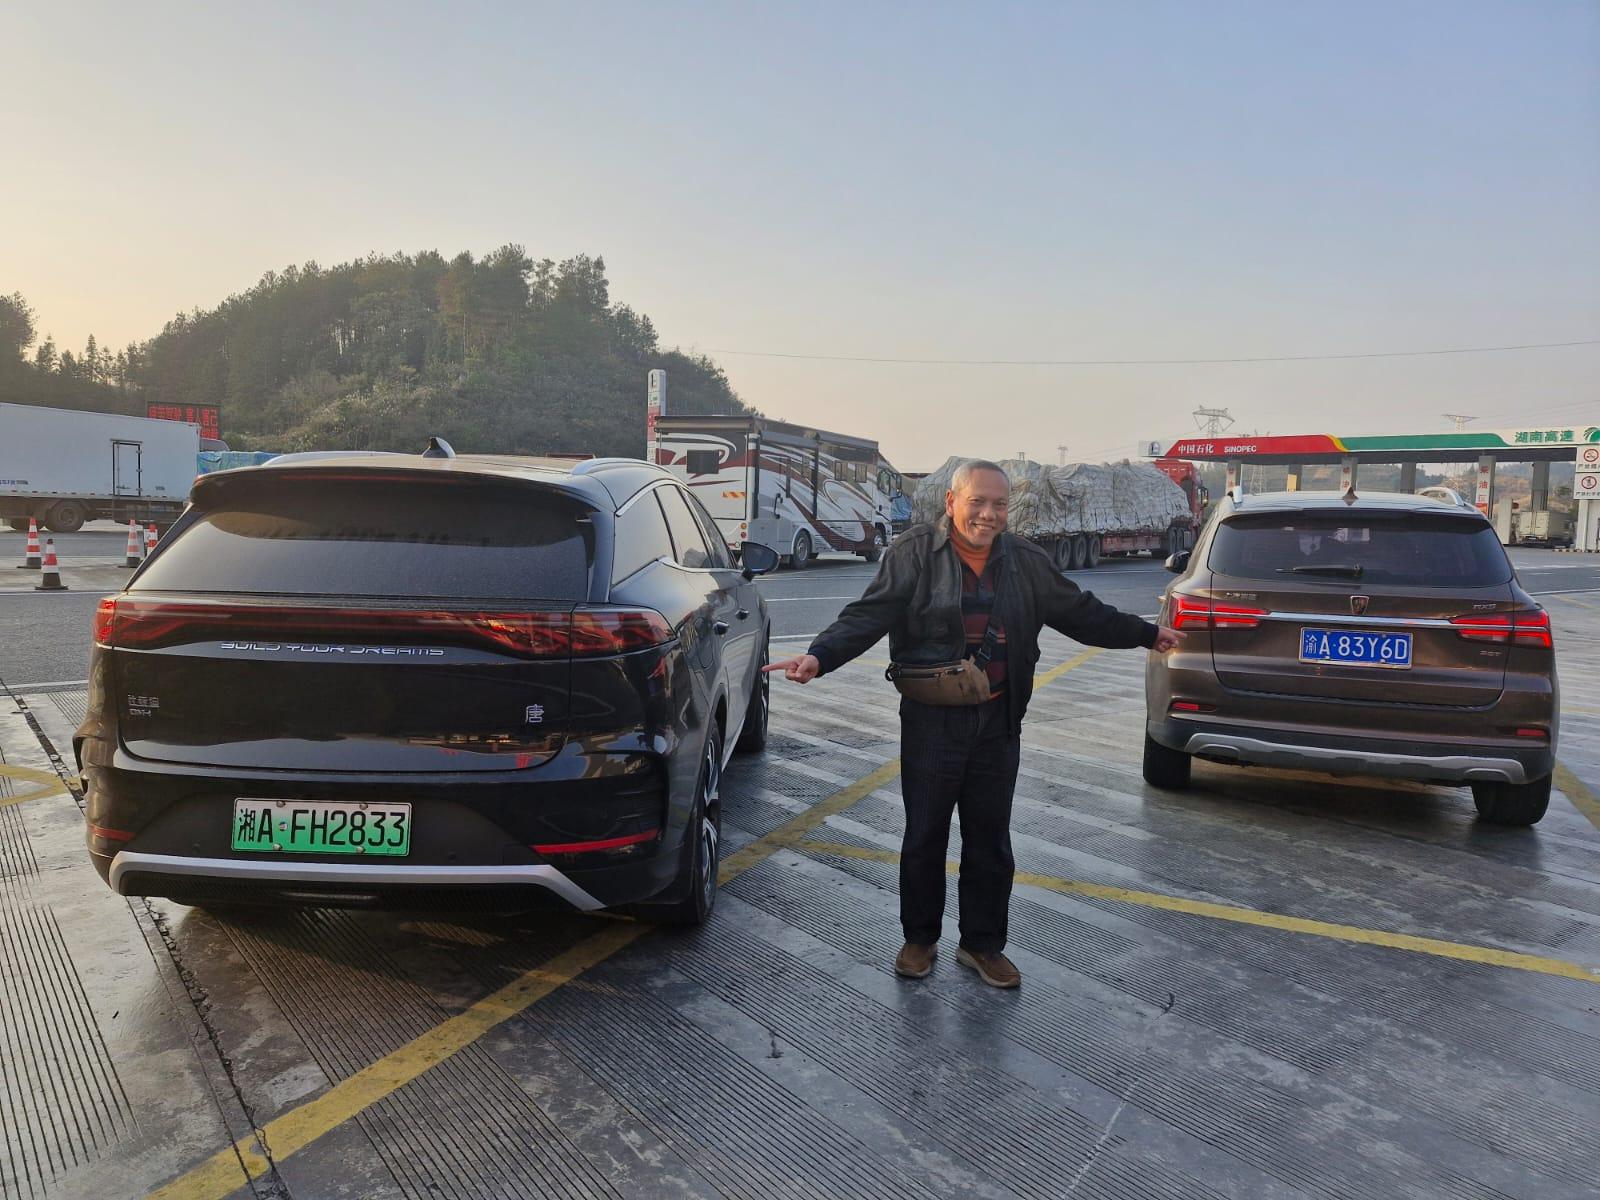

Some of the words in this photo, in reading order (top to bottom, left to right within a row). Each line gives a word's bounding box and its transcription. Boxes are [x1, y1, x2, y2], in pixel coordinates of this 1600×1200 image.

[1515, 430, 1574, 443] 湖南高速
[1178, 444, 1214, 454] 中国石化
[1224, 445, 1257, 453] SINOPEC
[221, 643, 281, 651] BUILD
[286, 644, 344, 653] YOUR
[350, 647, 444, 655] DREAMS
[525, 704, 545, 723] 唐
